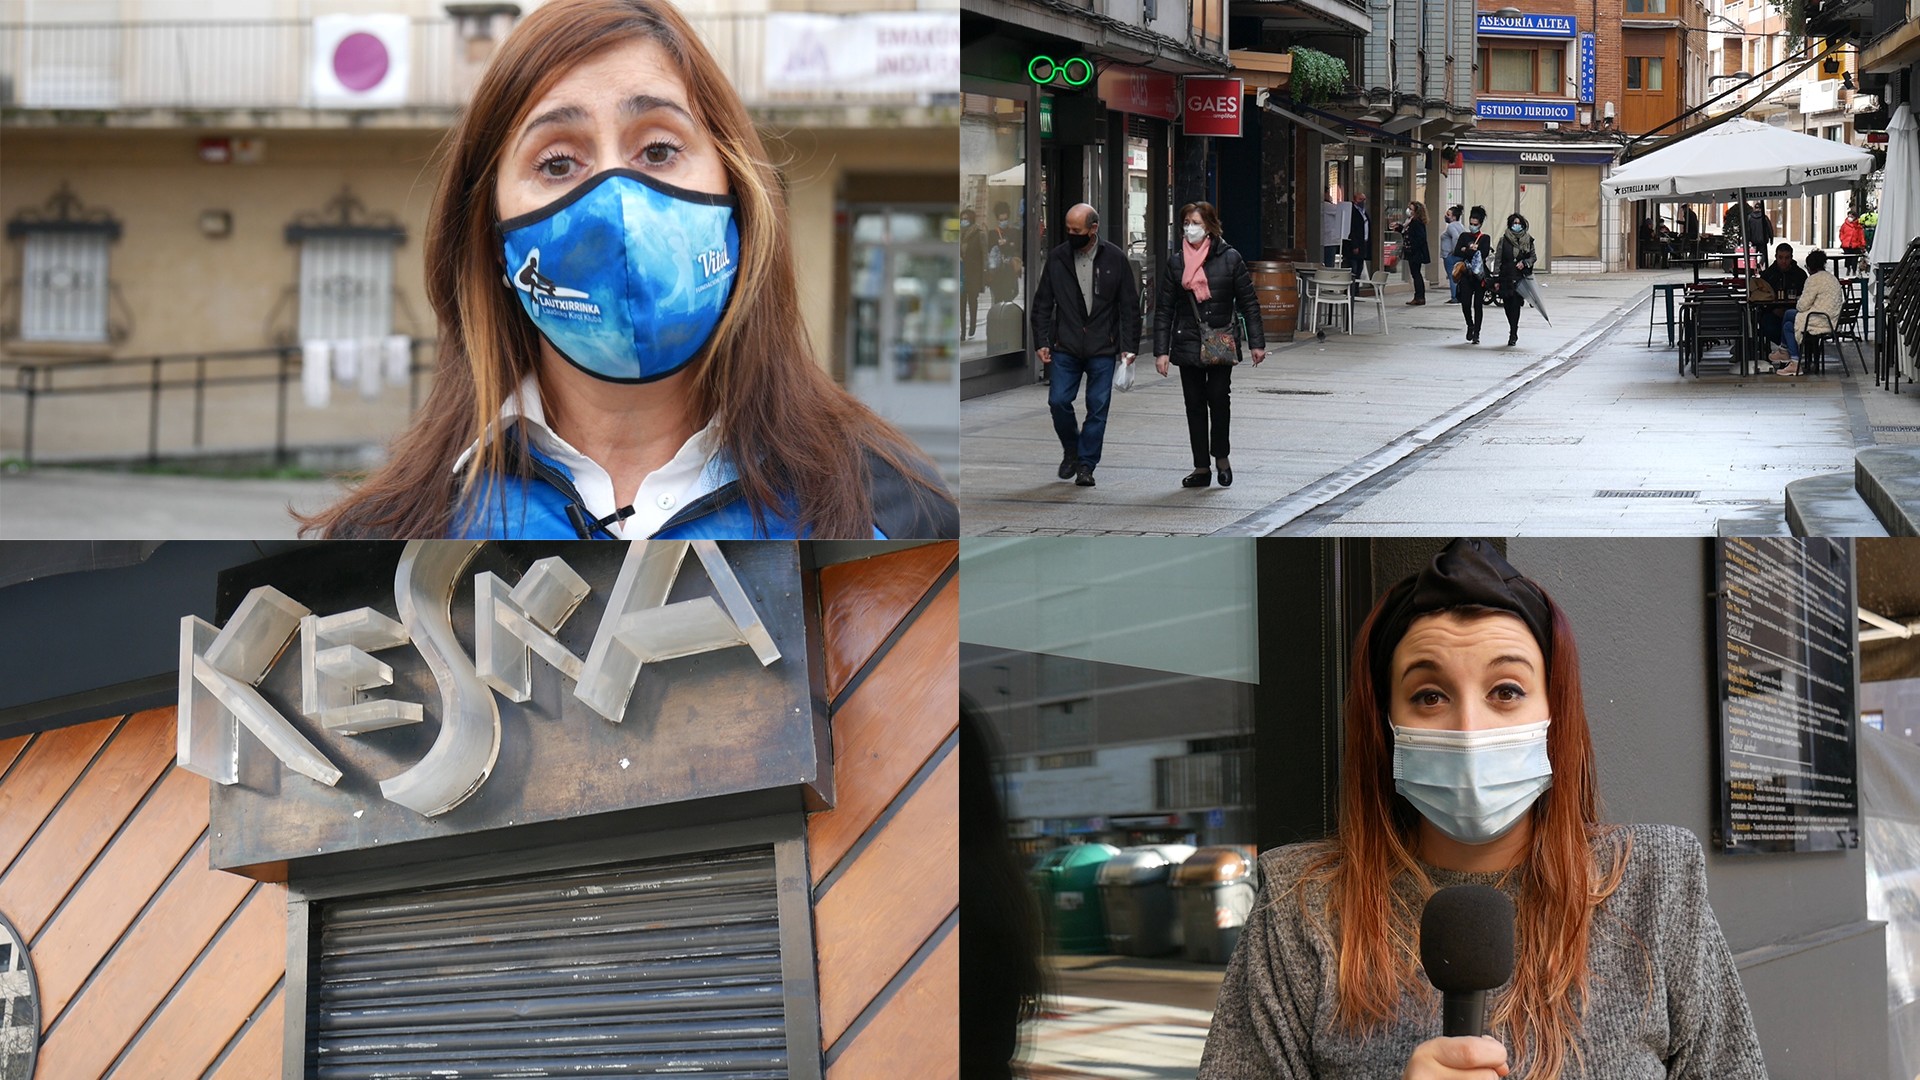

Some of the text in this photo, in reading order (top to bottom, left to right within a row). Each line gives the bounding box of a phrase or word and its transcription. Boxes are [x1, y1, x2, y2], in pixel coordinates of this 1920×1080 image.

[1536, 18, 1570, 29] ALTEA
[1188, 96, 1238, 113] GAES
[1480, 105, 1569, 117] ESTUDIO JURIDICO
[1520, 152, 1556, 162] CHAROL
[1813, 163, 1858, 176] ESTRELLA DAMM
[1621, 183, 1660, 195] ESTRELLA DAMM
[1745, 190, 1788, 199] TRELLA DAMM
[697, 241, 730, 278] Vital
[540, 297, 601, 315] LAUTXIRRINKA
